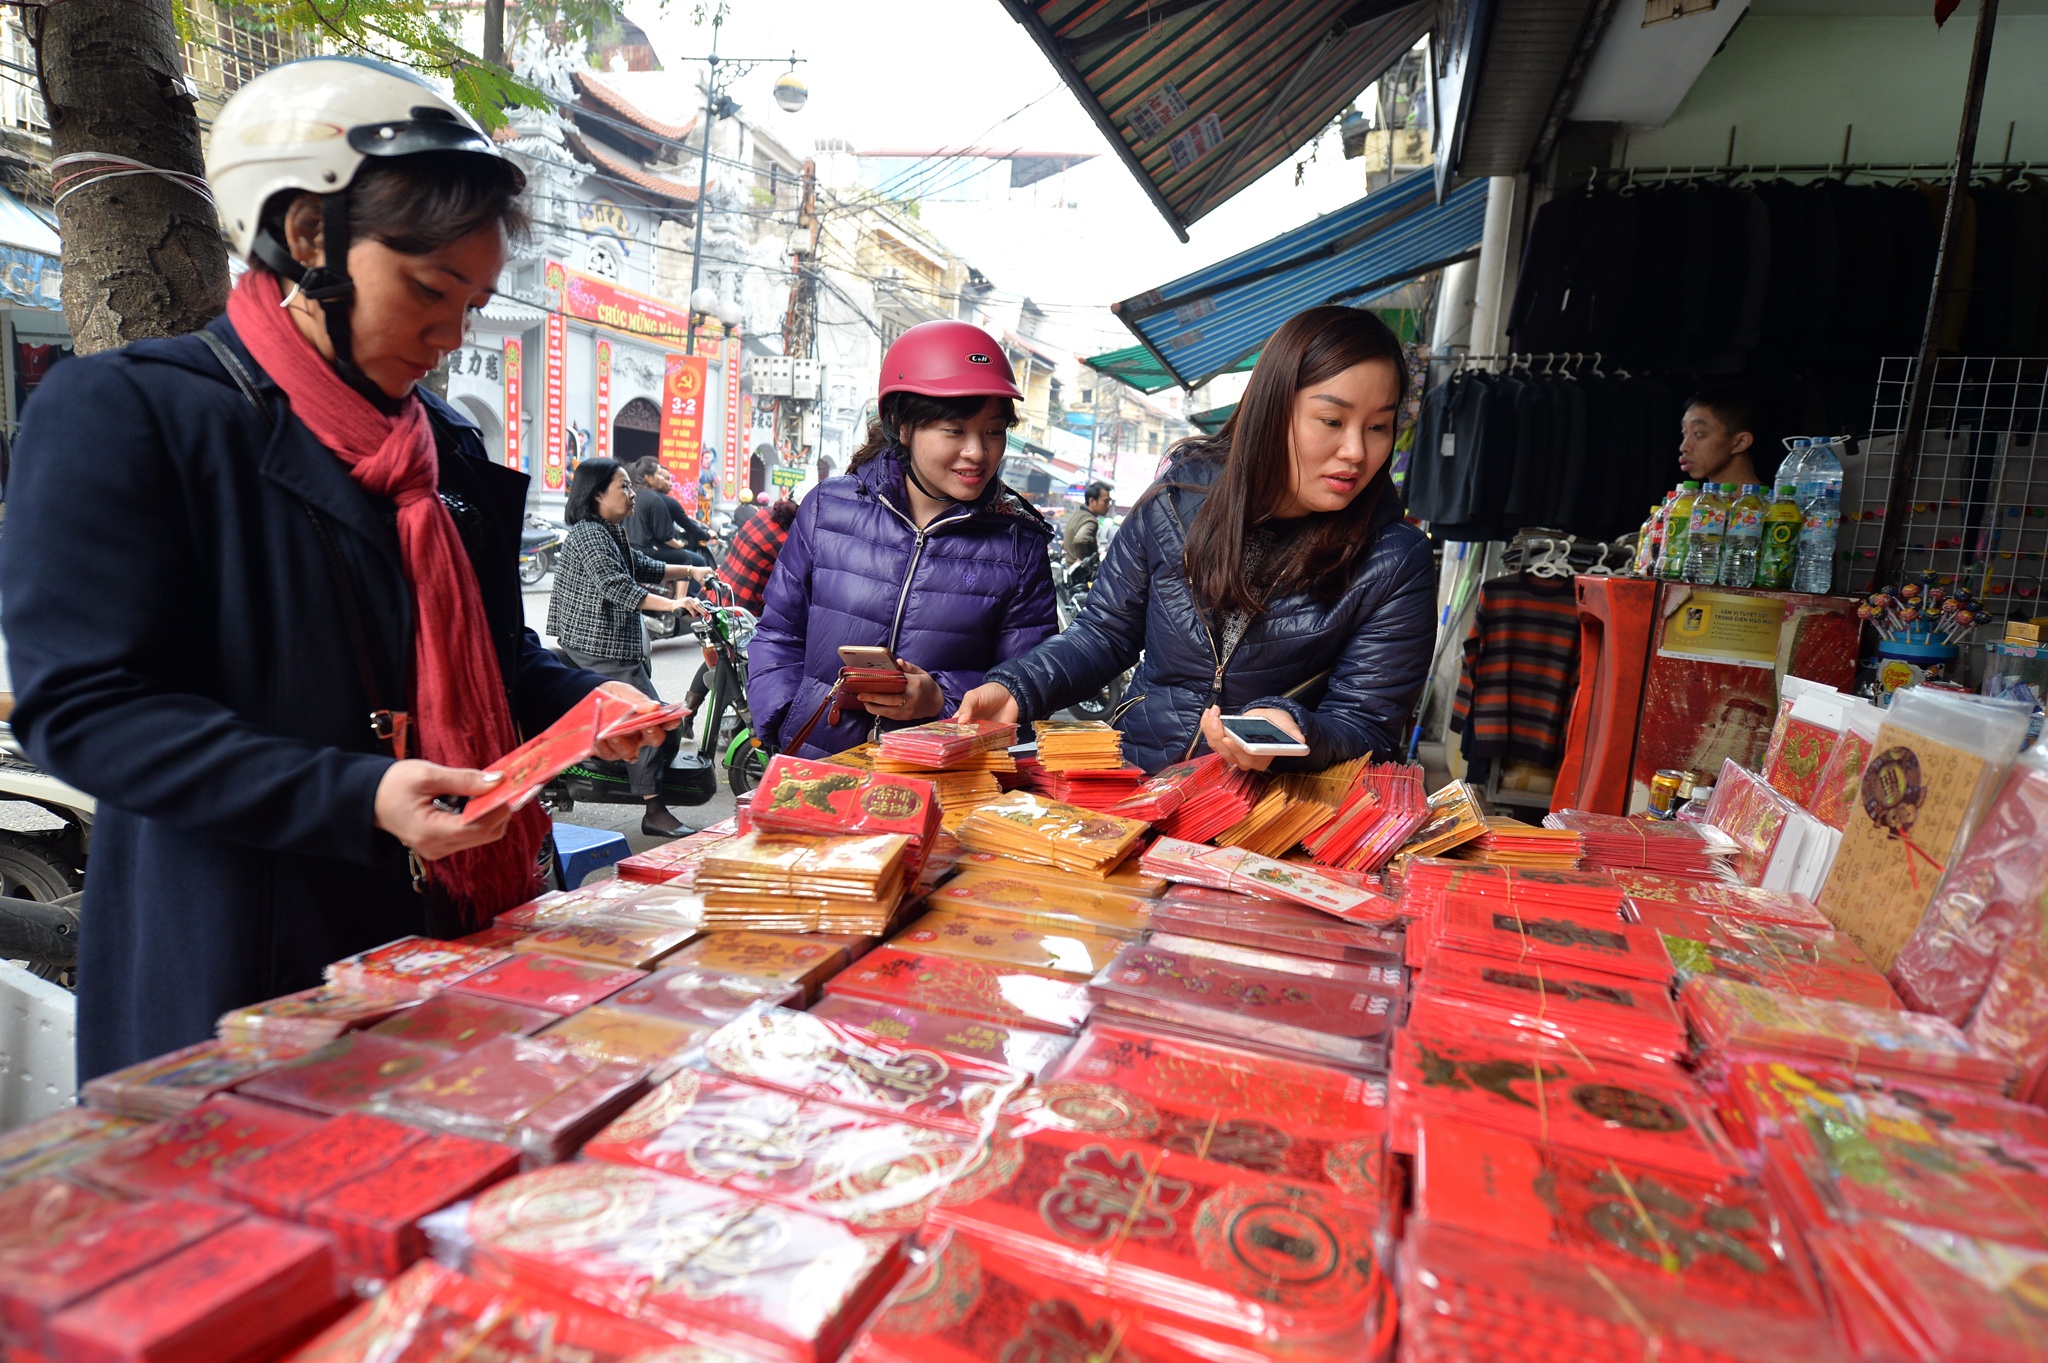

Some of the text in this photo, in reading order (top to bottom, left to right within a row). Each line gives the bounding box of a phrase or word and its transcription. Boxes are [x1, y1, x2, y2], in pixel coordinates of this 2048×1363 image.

[598, 302, 627, 327] CHÚC
[628, 311, 658, 334] MỪNG
[659, 322, 682, 343] NĂM
[1885, 669, 1911, 678] Chupa
[1884, 676, 1908, 688] Chups
